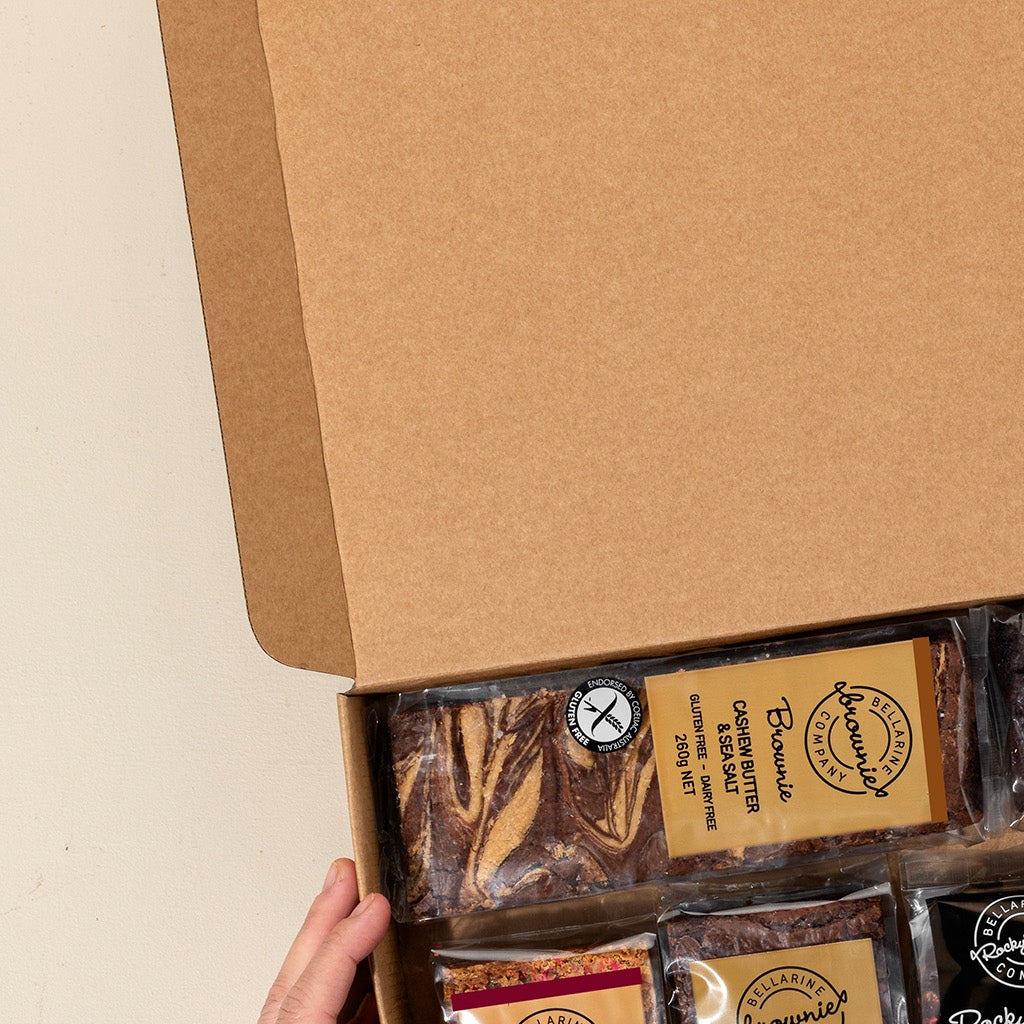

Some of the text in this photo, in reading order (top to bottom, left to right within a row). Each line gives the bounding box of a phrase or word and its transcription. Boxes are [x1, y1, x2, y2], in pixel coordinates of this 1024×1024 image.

[568, 691, 589, 746] GLUTEN FREE
[588, 679, 640, 751] ENDORSED BY COELIAC AUSTRALIA
[690, 694, 704, 732] GLUTEN
[835, 681, 888, 797] brownie
[872, 697, 900, 775] BELLARINE
[675, 734, 696, 795] 260g NET
[696, 735, 707, 760] FREE
[717, 724, 739, 794] & SEA SALT
[733, 700, 759, 814] CASHEW BUTTER
[766, 697, 794, 802] Brownie
[813, 711, 846, 782] COMPANY
[701, 776, 713, 804] DAIRY
[705, 806, 717, 831] FREE
[747, 973, 825, 1007] BELLARINE
